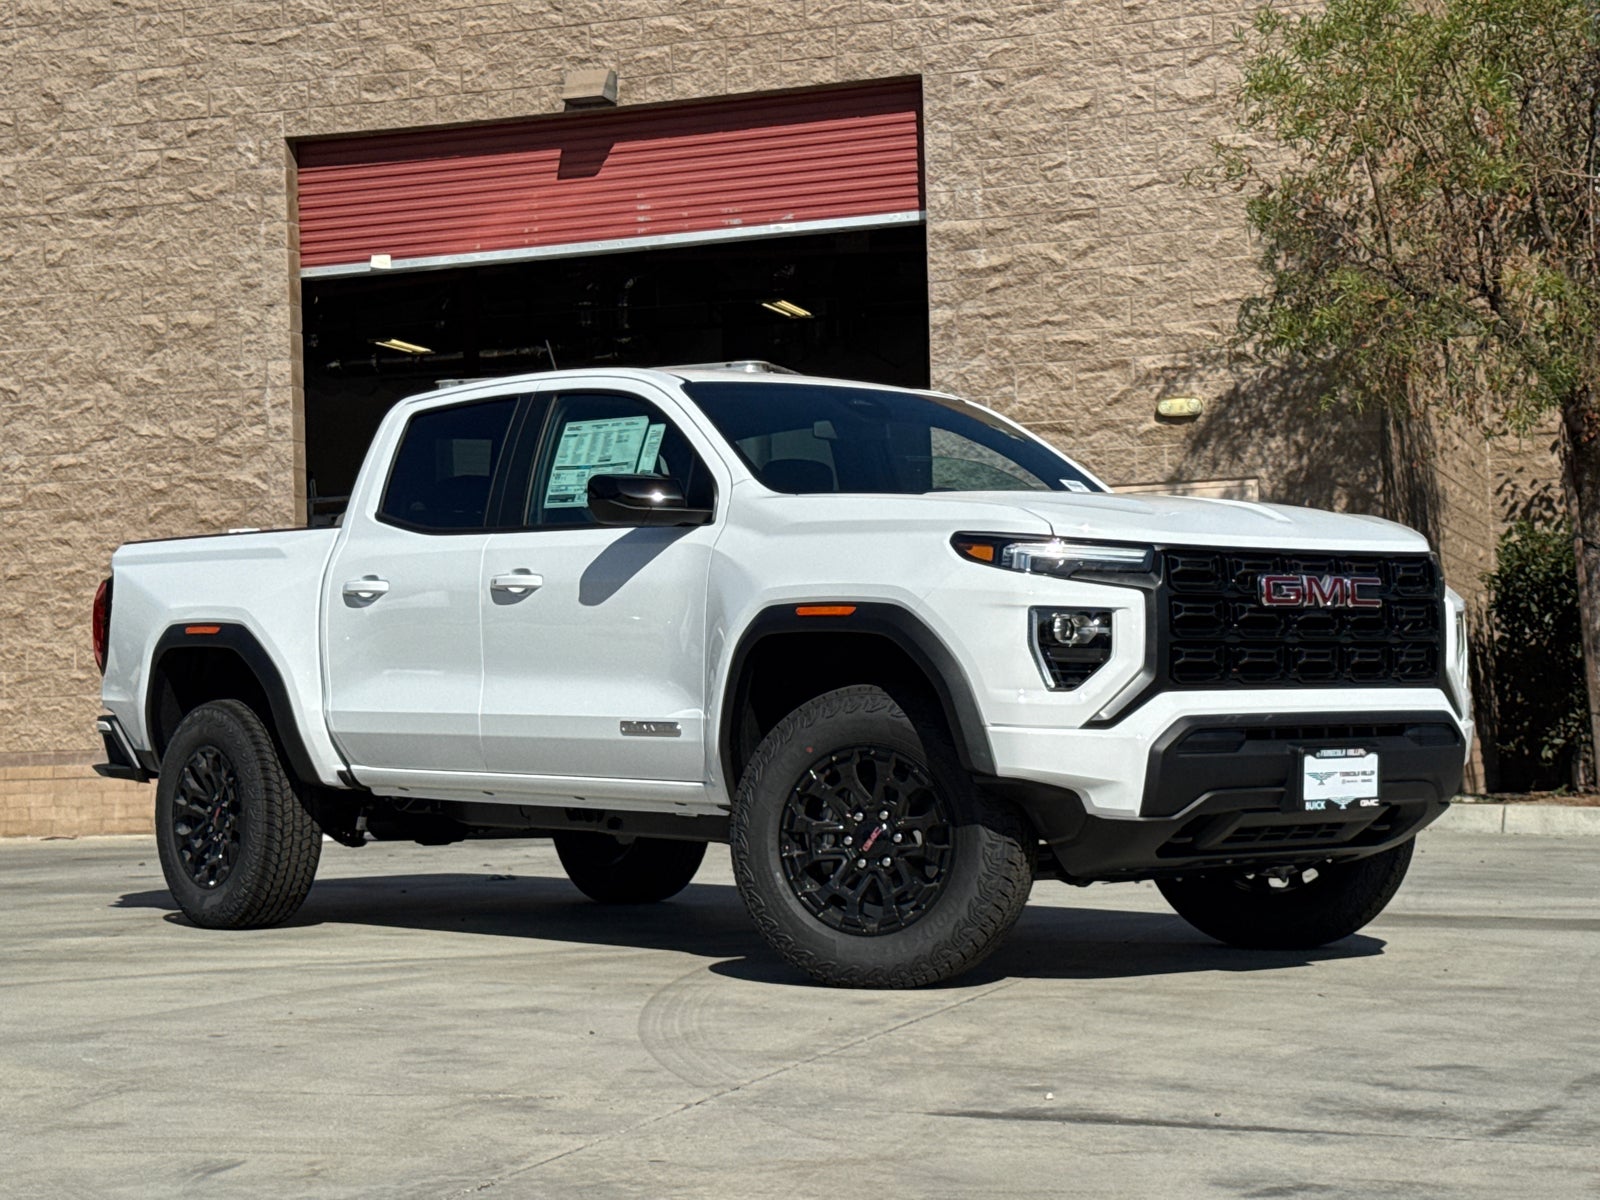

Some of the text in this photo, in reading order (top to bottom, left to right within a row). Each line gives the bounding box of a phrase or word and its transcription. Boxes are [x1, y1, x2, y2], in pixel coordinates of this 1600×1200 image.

[1260, 574, 1383, 608] GMC
[1305, 801, 1326, 811] BUICK
[1360, 799, 1379, 807] GMC
